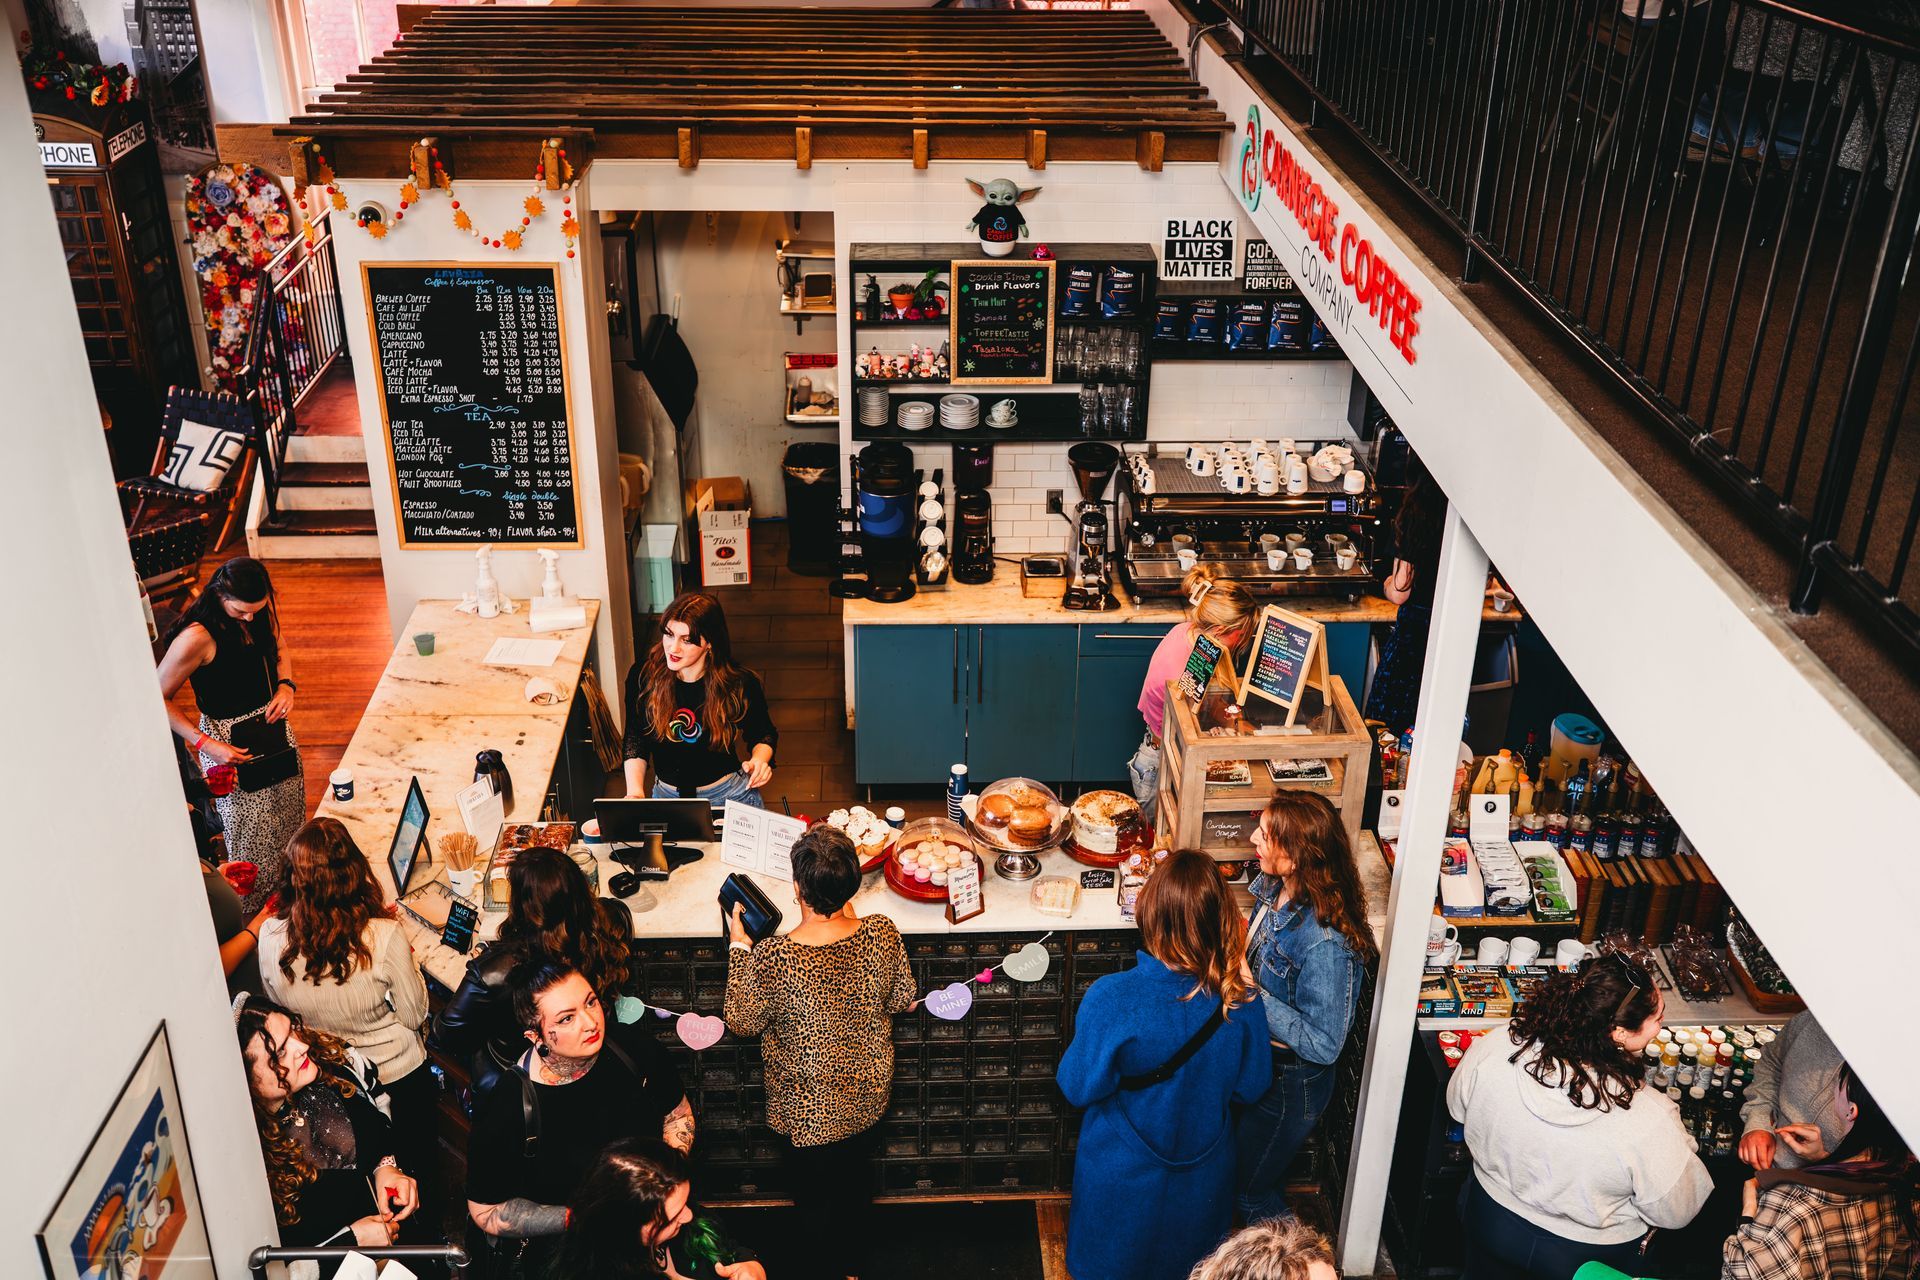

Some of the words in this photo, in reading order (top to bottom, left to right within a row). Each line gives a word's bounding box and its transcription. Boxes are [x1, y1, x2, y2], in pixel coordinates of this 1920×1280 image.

[109, 122, 145, 158] TELEPHONE
[1167, 220, 1233, 238] BLACK
[1175, 242, 1224, 258] LIVES
[1262, 129, 1340, 264] CARNEGIE
[1340, 222, 1423, 366] COFFEE
[1164, 261, 1233, 277] MATTER
[975, 283, 999, 291] Drink
[1245, 277, 1293, 290] FOREVER
[1301, 245, 1354, 335] COMPANY
[375, 294, 403, 303] BREWED
[405, 293, 431, 303] COFFEE
[475, 295, 492, 303] 2.25
[497, 295, 513, 303] 2.55
[519, 295, 534, 303] 2.90
[539, 295, 555, 303] 3.25
[399, 304, 408, 312] AU
[411, 304, 427, 312] LAIT
[476, 304, 493, 312] 2.45
[498, 304, 514, 312] 2.75
[520, 304, 535, 312] 3.10
[539, 304, 555, 312] 3.45
[378, 313, 394, 321] ICED
[396, 312, 420, 321] COFFEE
[378, 321, 395, 330] COLD
[398, 321, 416, 330] BREW
[380, 331, 422, 340] AMERICANO
[480, 331, 497, 340] 2.75
[500, 331, 518, 340] 3.20
[523, 331, 539, 340] 3.60
[542, 331, 557, 340] 4.00
[381, 340, 425, 349] CAPPUCCINO
[481, 340, 497, 348] 3.40
[501, 340, 517, 348] 3.75
[523, 340, 539, 348] 4.20
[542, 340, 557, 348] 4.70
[383, 349, 408, 358] LATTE
[383, 359, 408, 367] LATTE
[415, 358, 443, 367] FLAVOR
[407, 367, 433, 376] MOCHA
[387, 377, 403, 385] ICED
[406, 377, 428, 385] LATTE
[387, 386, 404, 394] ICED
[406, 386, 427, 394] LATTE
[433, 385, 459, 394] FLAVOR
[505, 386, 522, 394] 4.65
[528, 386, 543, 394] 5.20
[547, 386, 562, 394] 5.80
[400, 394, 421, 403] EXTRA
[423, 393, 454, 403] ESPRESSO
[459, 394, 476, 403] SHOT
[517, 395, 533, 403] 1.75
[464, 412, 491, 421] TEA
[391, 420, 407, 429] HOT
[411, 420, 424, 429] TEA
[489, 421, 506, 429] 2.90
[510, 421, 527, 429] 3.00
[532, 421, 546, 429] 3.10
[551, 421, 566, 429] 3.20
[393, 429, 409, 437] ICED
[411, 429, 424, 437] TEA
[393, 437, 413, 446] CHAI
[415, 437, 441, 446] LATTE
[394, 445, 426, 454] MATCHA
[429, 446, 452, 454] LATTE
[429, 453, 444, 464] FOG
[398, 470, 414, 478] HOT
[415, 468, 455, 478] CHOCOLATE
[494, 470, 509, 478] 3.00
[515, 470, 530, 478] 3.50
[536, 470, 551, 478] 4.00
[554, 470, 570, 478] 4.50
[399, 479, 420, 488] FRUIT
[423, 478, 462, 488] SMOOTHIES
[515, 479, 530, 487] 4.50
[537, 479, 553, 487] 5.50
[555, 479, 571, 487] 6.50
[402, 500, 437, 509] ESPRESSO
[508, 501, 524, 509] 3.00
[537, 501, 553, 509] 3.50
[404, 508, 475, 519] MACCHIATO/CORTADO
[509, 511, 525, 520] 3.40
[538, 511, 555, 520] 3.70
[414, 525, 434, 536] MILK
[435, 525, 482, 537] alternatives
[506, 526, 535, 536] FLAVOR
[713, 537, 737, 545] Tito's
[1012, 953, 1045, 977] SMILE
[939, 990, 955, 1001] BE
[935, 997, 968, 1014] MINE
[686, 1020, 718, 1031] TRUE
[681, 1030, 715, 1041] LOVE
